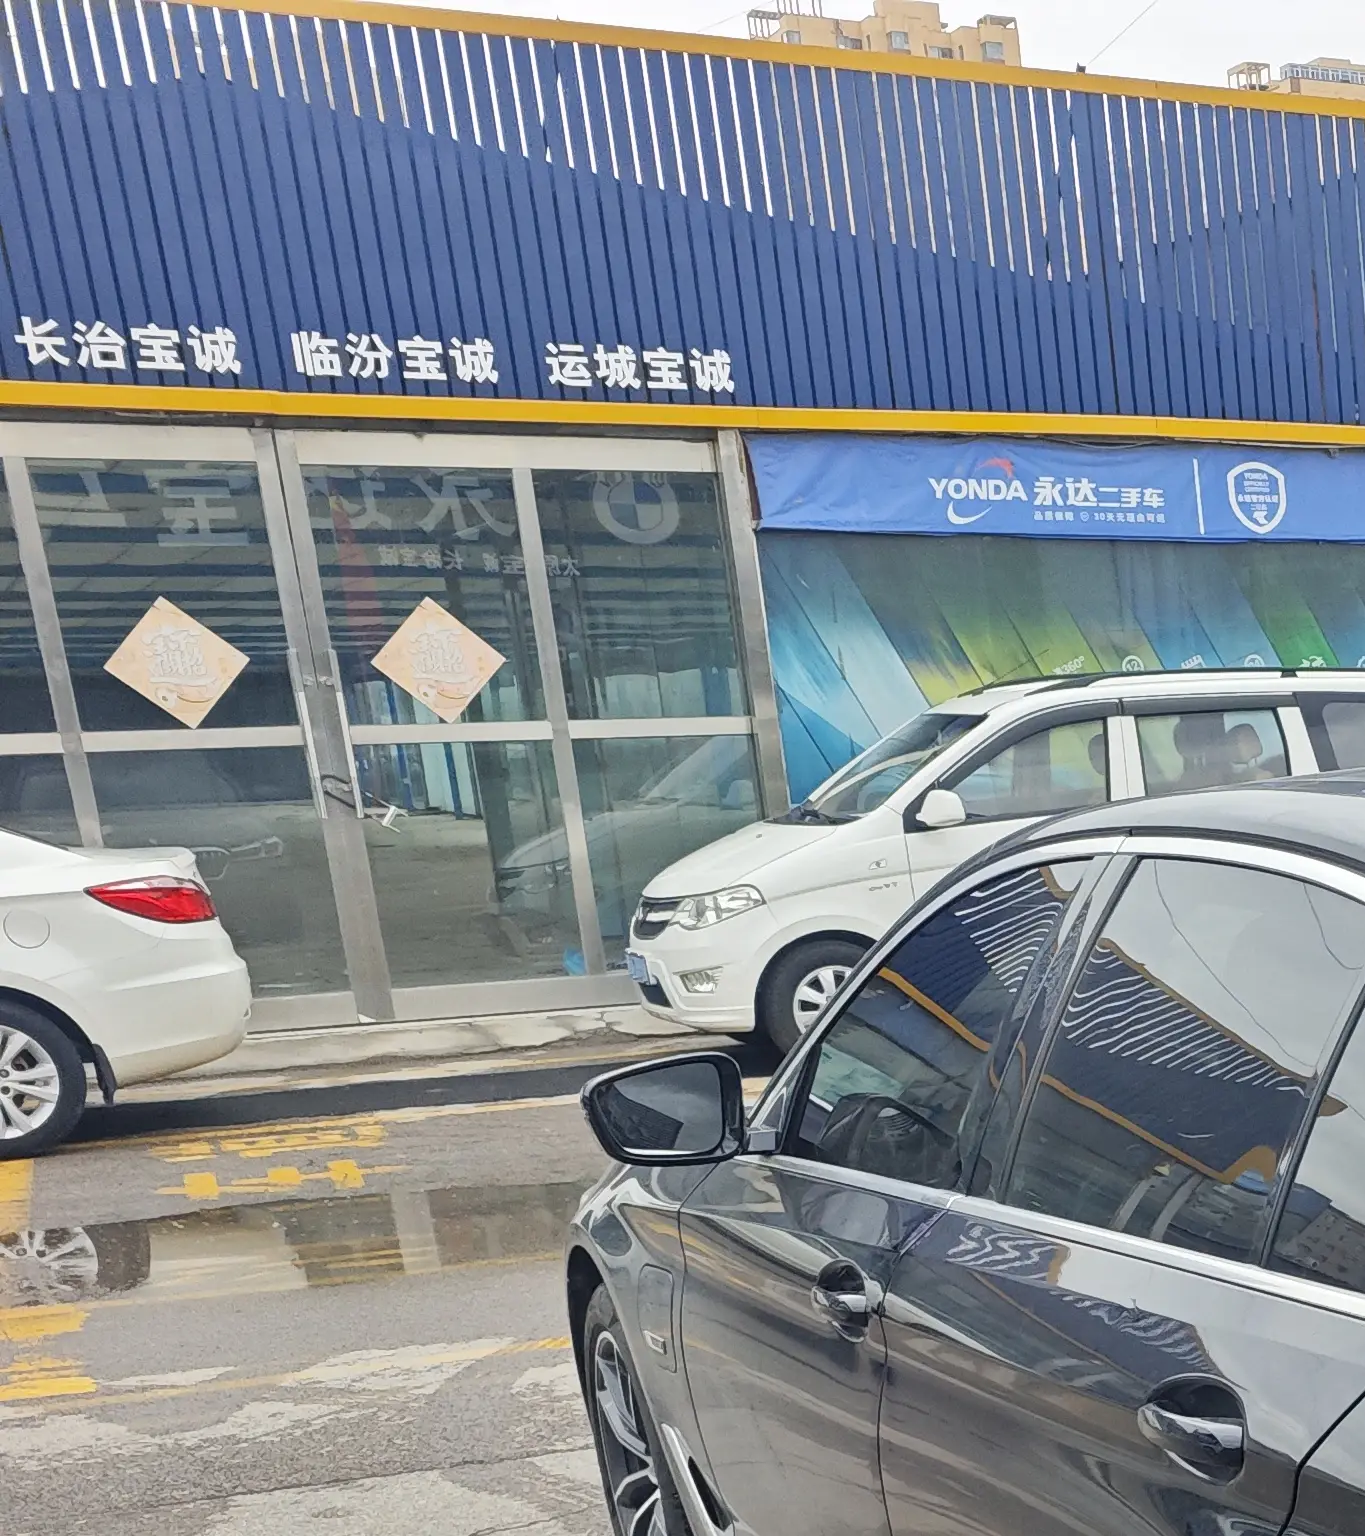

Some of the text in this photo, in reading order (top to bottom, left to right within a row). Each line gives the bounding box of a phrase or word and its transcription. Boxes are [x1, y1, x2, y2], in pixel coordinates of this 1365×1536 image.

[14, 315, 735, 394] 长治宝诚 临汾宝诚 运城宝诚
[928, 476, 1166, 508] YONDA 永达二手车
